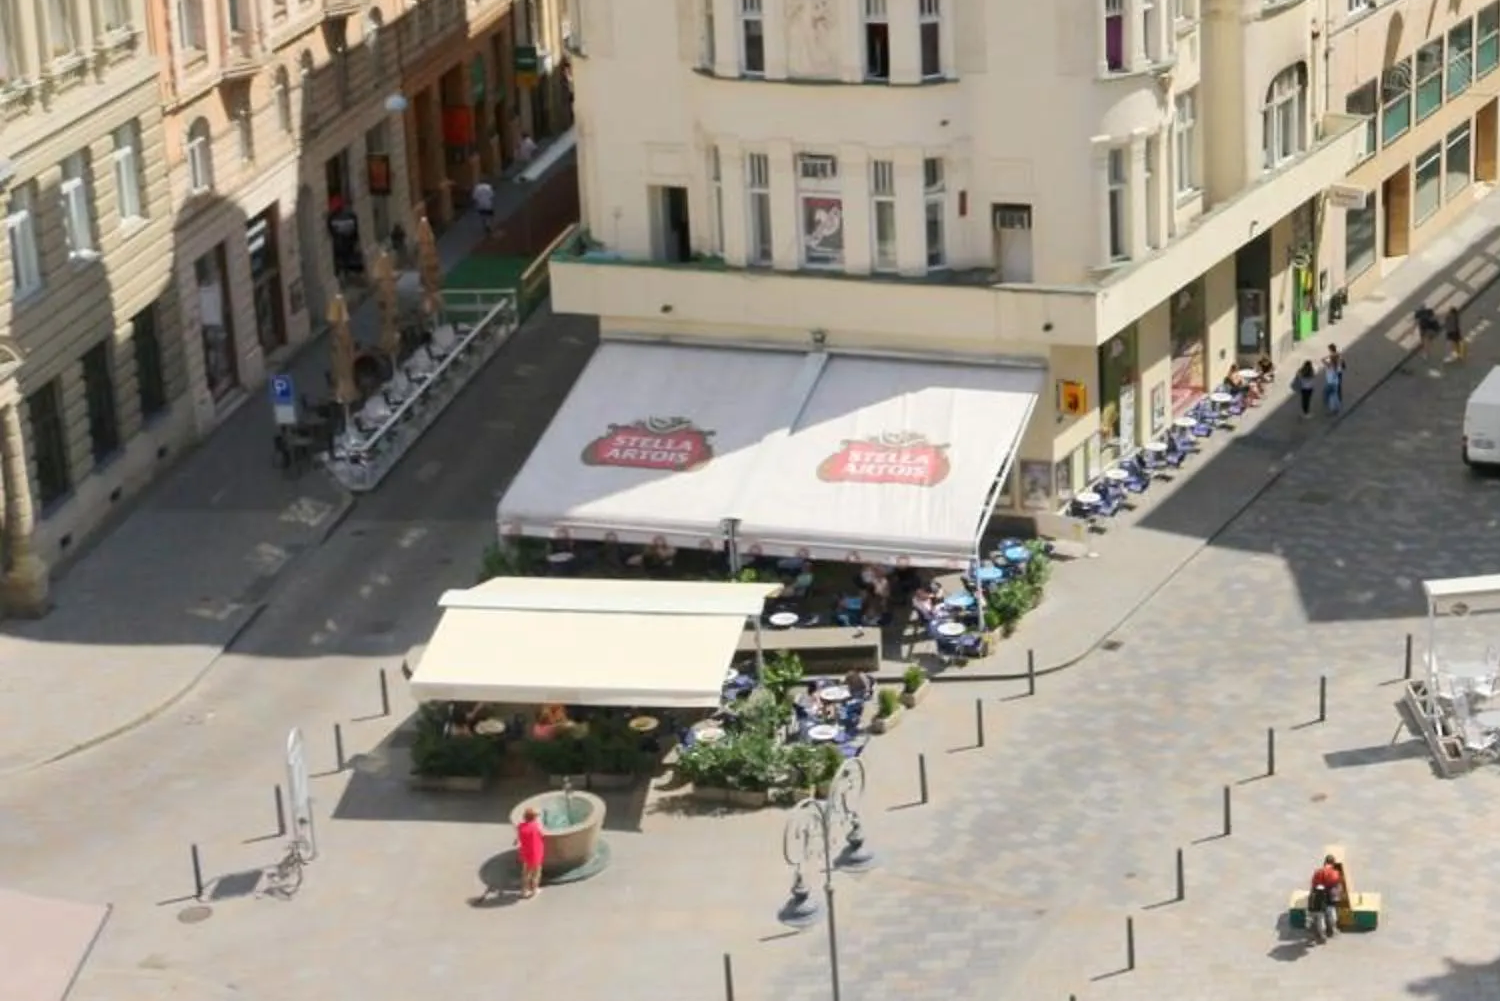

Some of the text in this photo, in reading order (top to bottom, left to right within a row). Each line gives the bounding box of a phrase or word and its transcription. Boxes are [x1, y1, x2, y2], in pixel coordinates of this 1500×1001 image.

[611, 435, 693, 452] STELLA
[603, 448, 691, 463] ARTOIS
[847, 449, 930, 465] STELLA
[841, 462, 929, 479] ARTOIS
